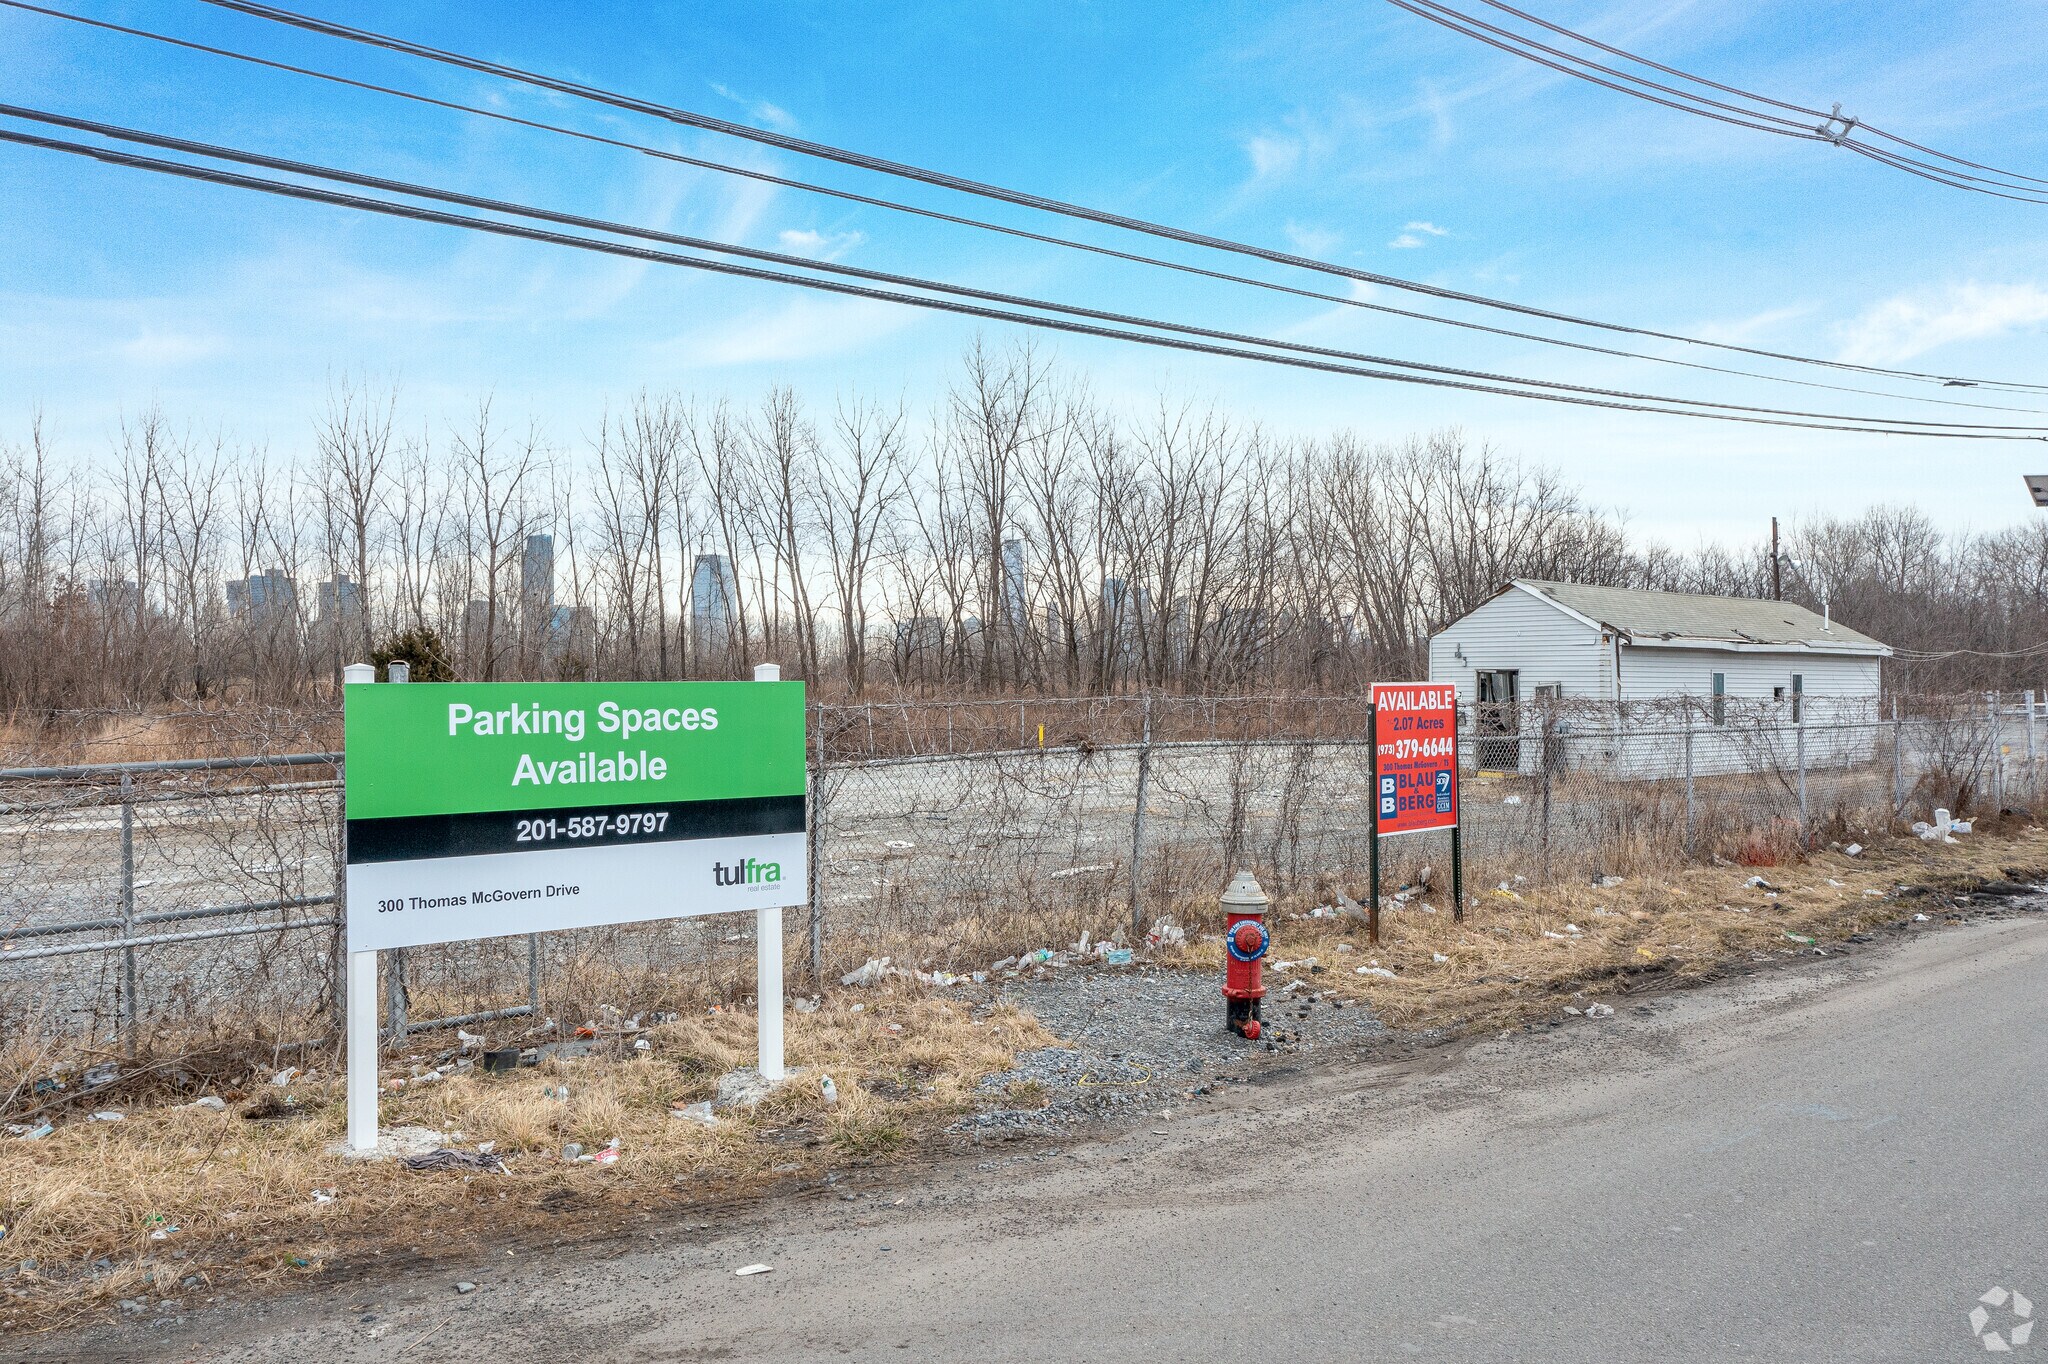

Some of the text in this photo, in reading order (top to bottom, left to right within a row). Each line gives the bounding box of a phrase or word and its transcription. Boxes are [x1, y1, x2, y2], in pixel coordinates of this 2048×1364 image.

[1378, 690, 1452, 711] AVAILABLE
[447, 701, 719, 742] Parking Spaces
[1393, 716, 1445, 731] 2.07 Acres
[1377, 737, 1453, 759] (973) 379-6644
[511, 751, 668, 786] Available
[1381, 778, 1396, 794] B
[1398, 771, 1434, 789] BLAU
[1381, 797, 1396, 814] B
[1398, 793, 1435, 811] BERG
[516, 812, 669, 842] 201-587-9797
[712, 857, 781, 887] tulfra
[377, 883, 581, 913] 300 Thomas McGovern Drive
[747, 883, 781, 893] real estate
